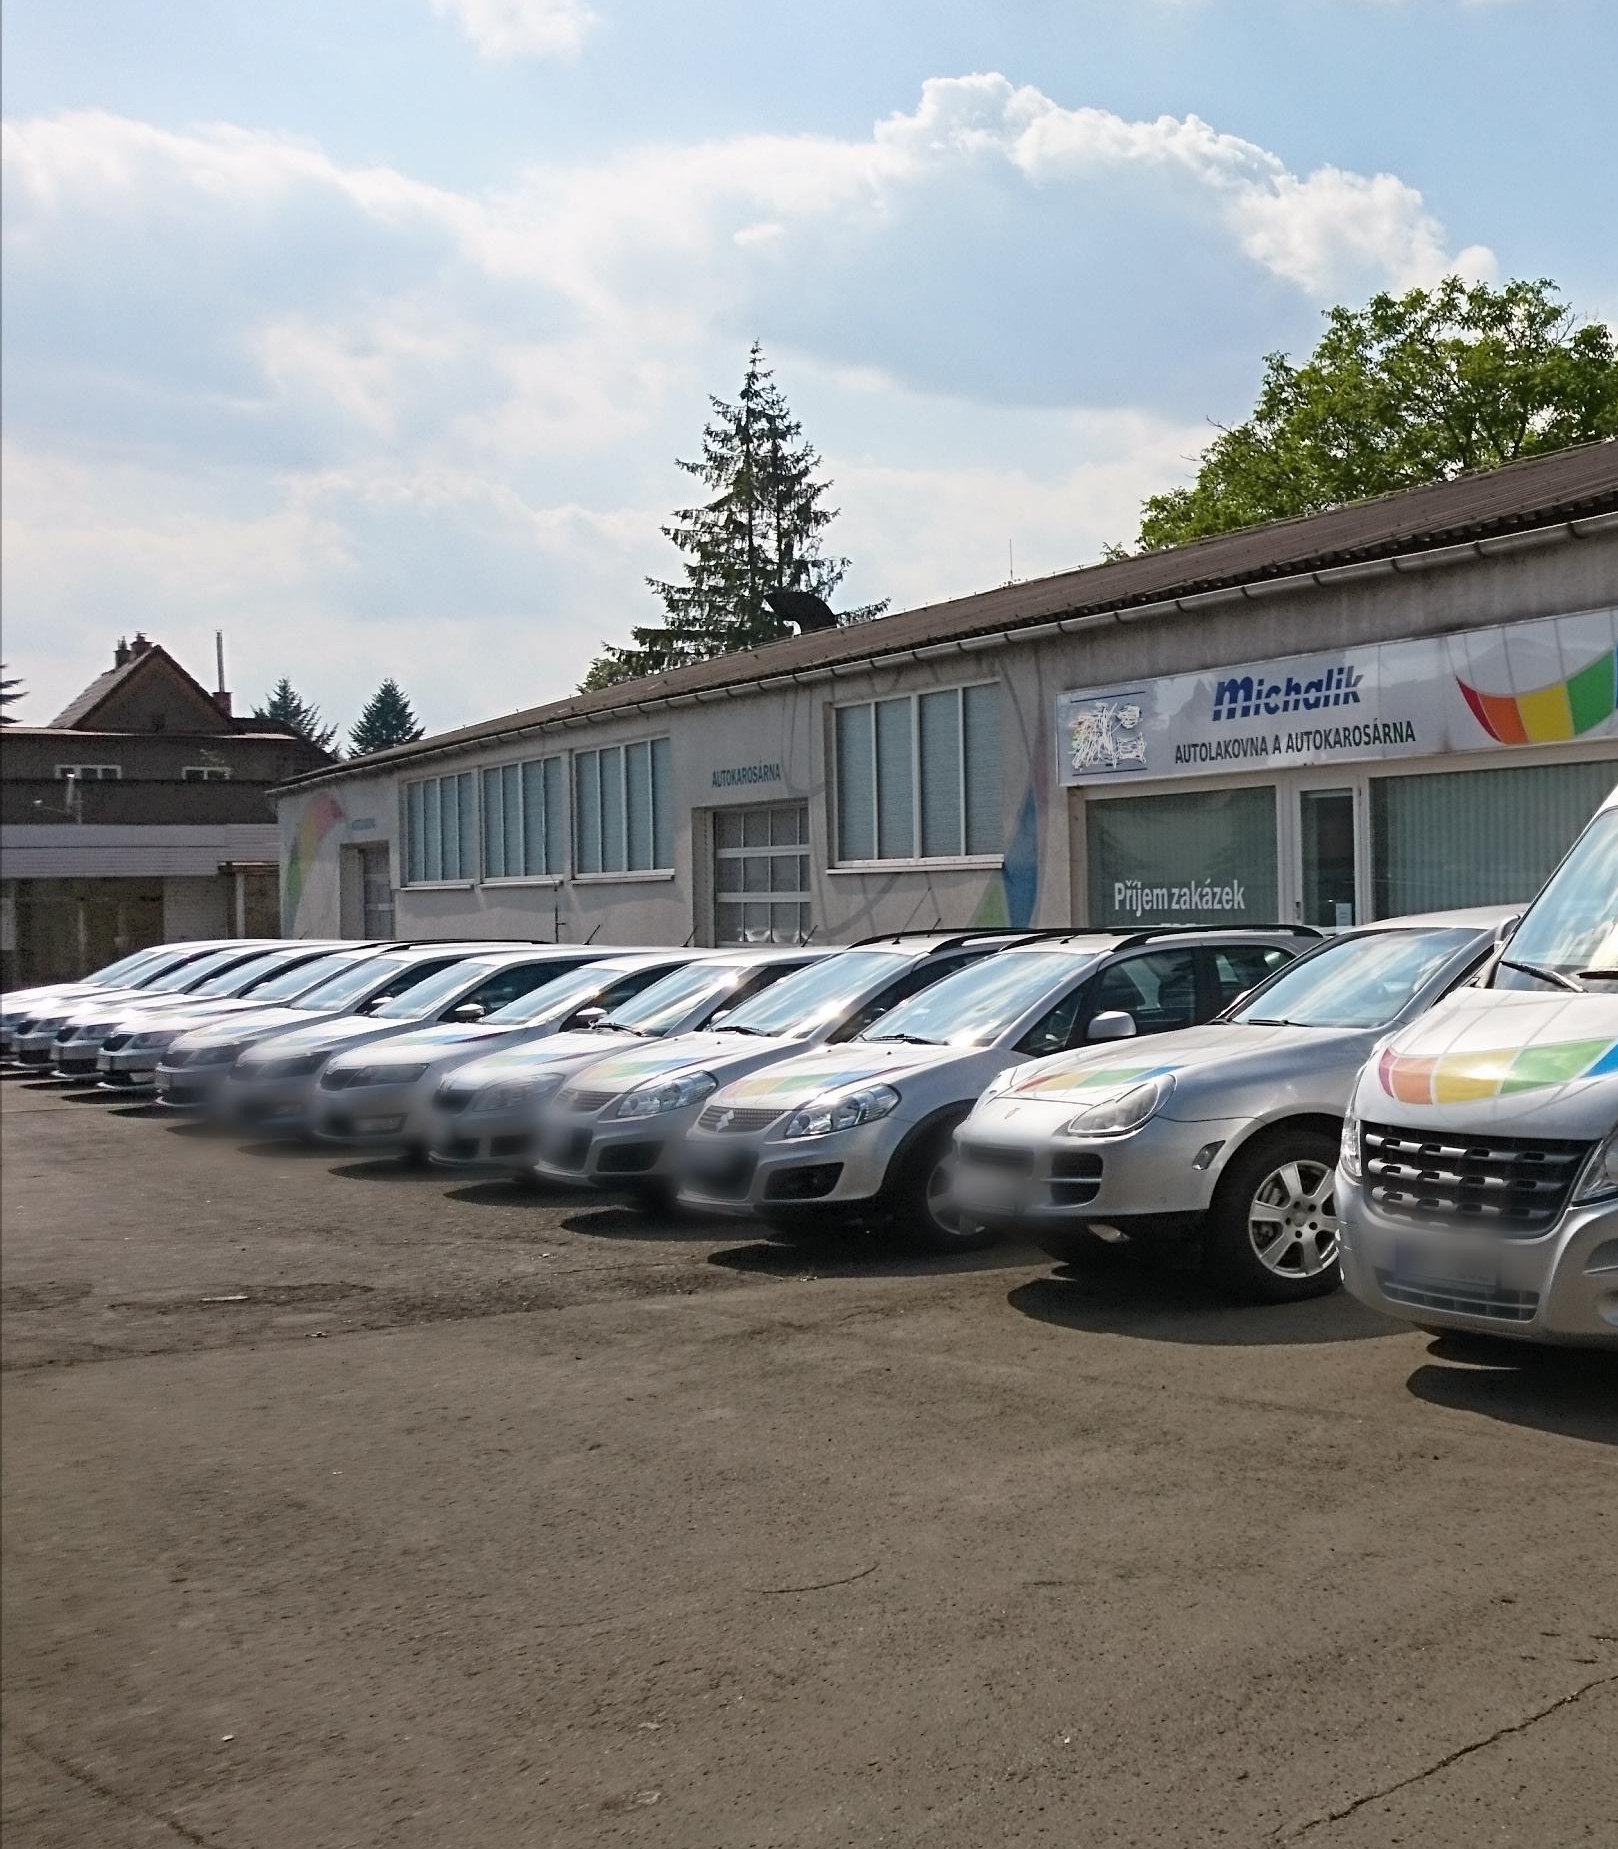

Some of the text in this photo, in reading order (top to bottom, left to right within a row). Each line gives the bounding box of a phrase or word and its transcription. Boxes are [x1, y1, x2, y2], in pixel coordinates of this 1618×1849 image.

[1175, 718, 1416, 764] AUTOLAKOVNA A AUTOKAROSÁRNA
[712, 760, 781, 787] AUTOKAROSÁRNA
[1114, 878, 1245, 917] Příjem zakázek
